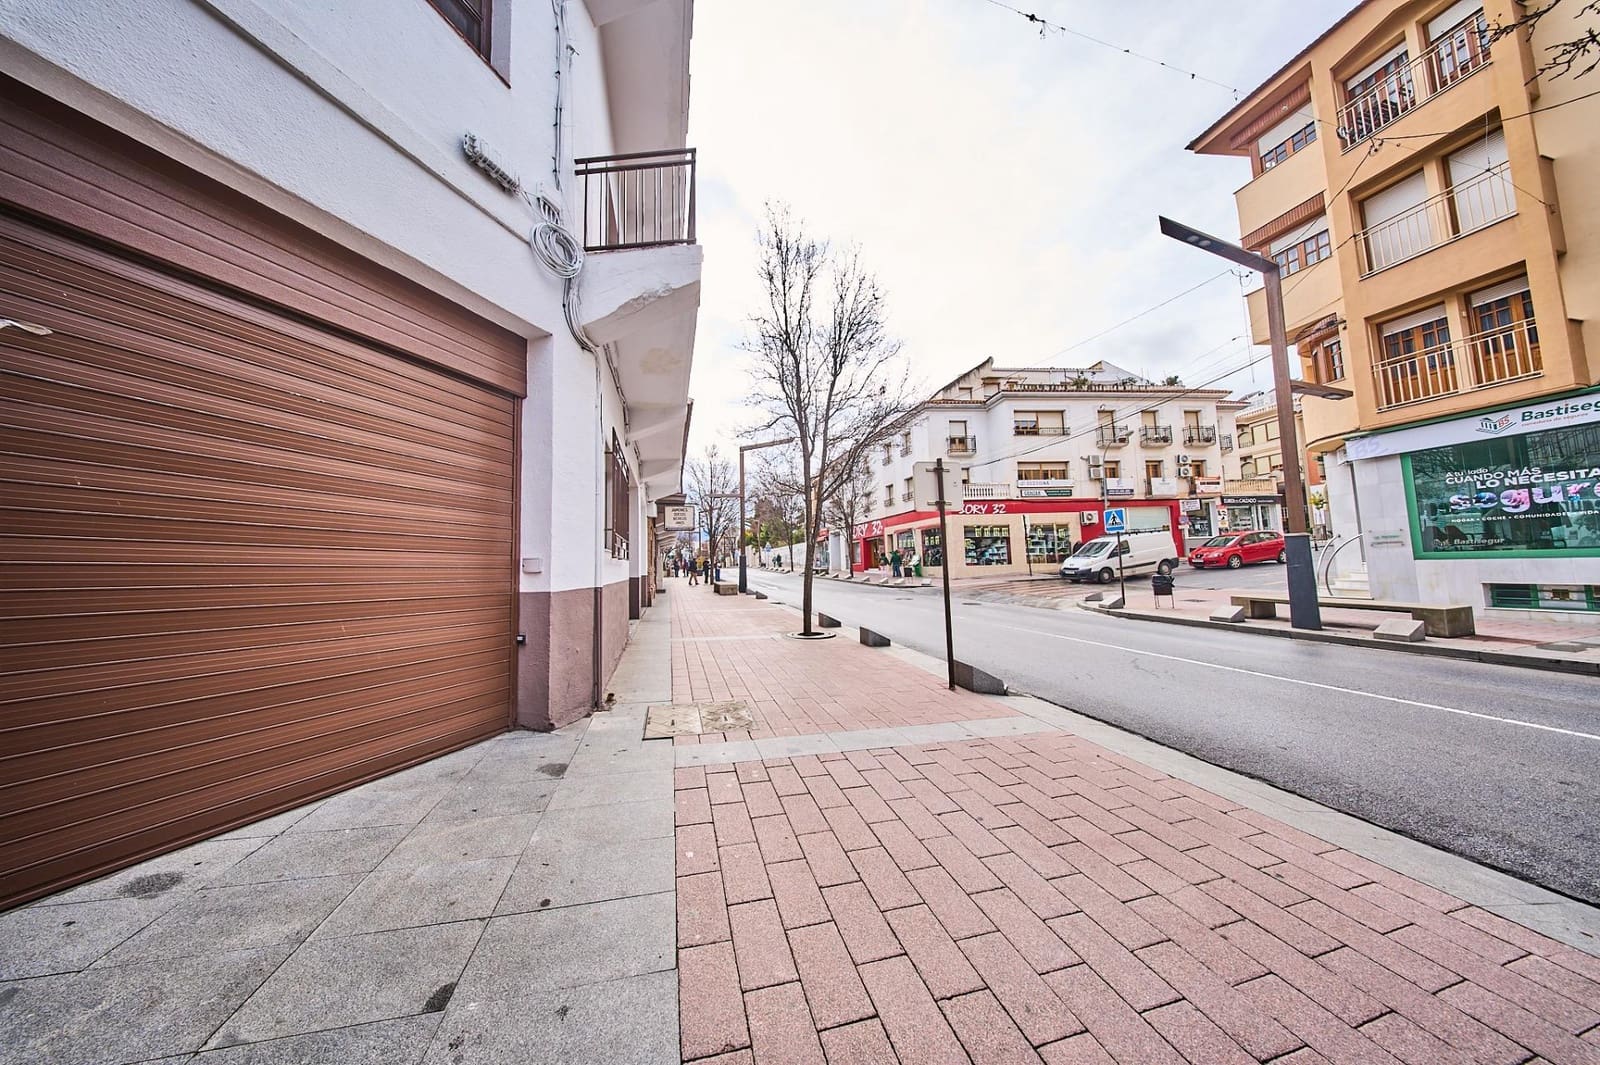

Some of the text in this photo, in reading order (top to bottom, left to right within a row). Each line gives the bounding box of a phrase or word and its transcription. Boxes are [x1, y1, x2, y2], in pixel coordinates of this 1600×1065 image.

[1445, 466, 1541, 485] CUANDO MÁS
[1476, 467, 1600, 489] LO NECESITA
[991, 503, 1007, 514] 32
